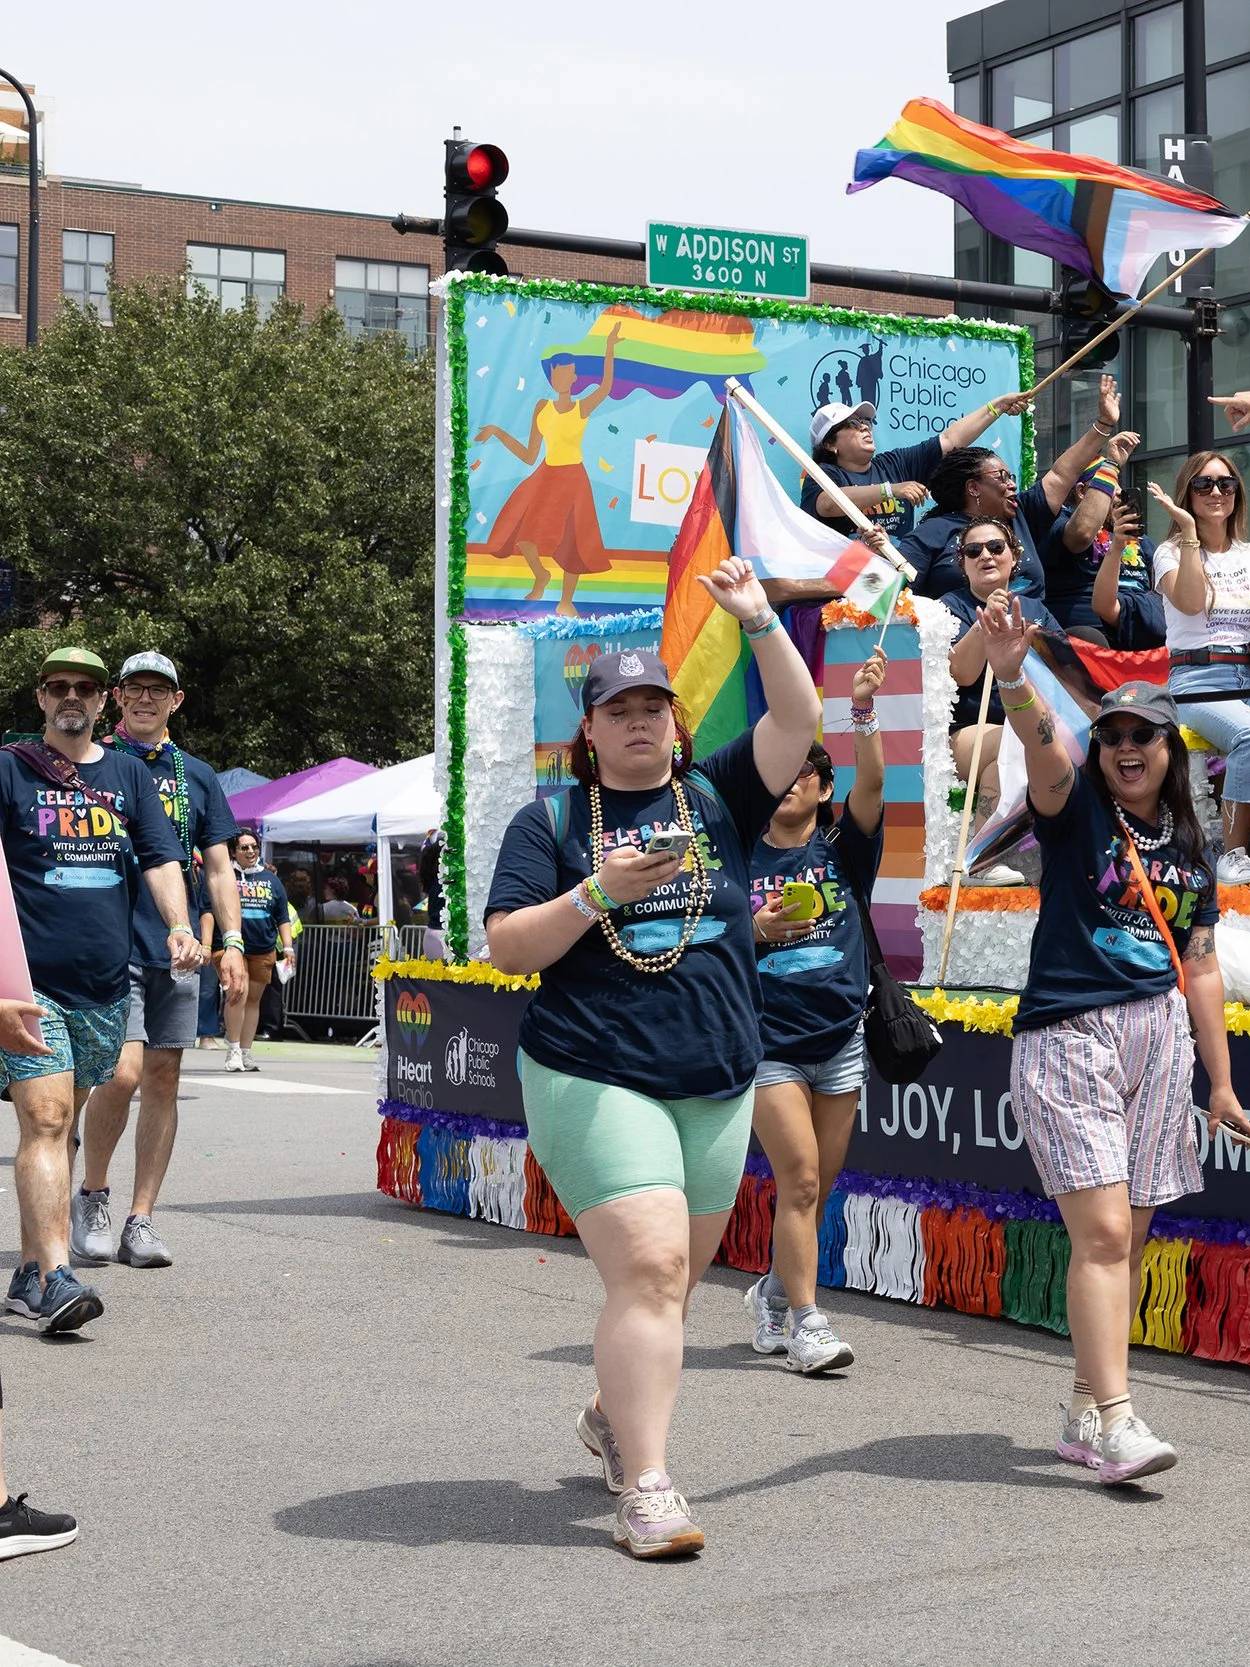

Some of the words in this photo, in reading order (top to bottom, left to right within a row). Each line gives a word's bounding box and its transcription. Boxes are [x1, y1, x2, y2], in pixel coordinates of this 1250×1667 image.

[655, 234, 668, 252] W
[676, 233, 775, 267] ADDISON
[782, 247, 800, 264] ST
[692, 264, 742, 285] 3600
[755, 270, 766, 288] N
[889, 354, 986, 389] Chicago
[890, 381, 957, 408] Public
[889, 407, 963, 433] Schoo
[638, 463, 700, 504] LO
[53, 842, 75, 851] WITH
[76, 842, 95, 852] JOY,
[97, 842, 121, 852] LOVE,
[56, 853, 63, 861] &
[64, 853, 117, 862] COMMUNITY
[652, 883, 680, 897] JOY,
[623, 905, 632, 917] &
[467, 1037, 500, 1058] Chicago
[397, 1054, 433, 1084] iHeart
[468, 1053, 490, 1071] Public
[468, 1070, 496, 1088] Schools
[397, 1082, 434, 1110] Radio
[880, 1083, 961, 1155] JOY,
[973, 1088, 1024, 1151] LO
